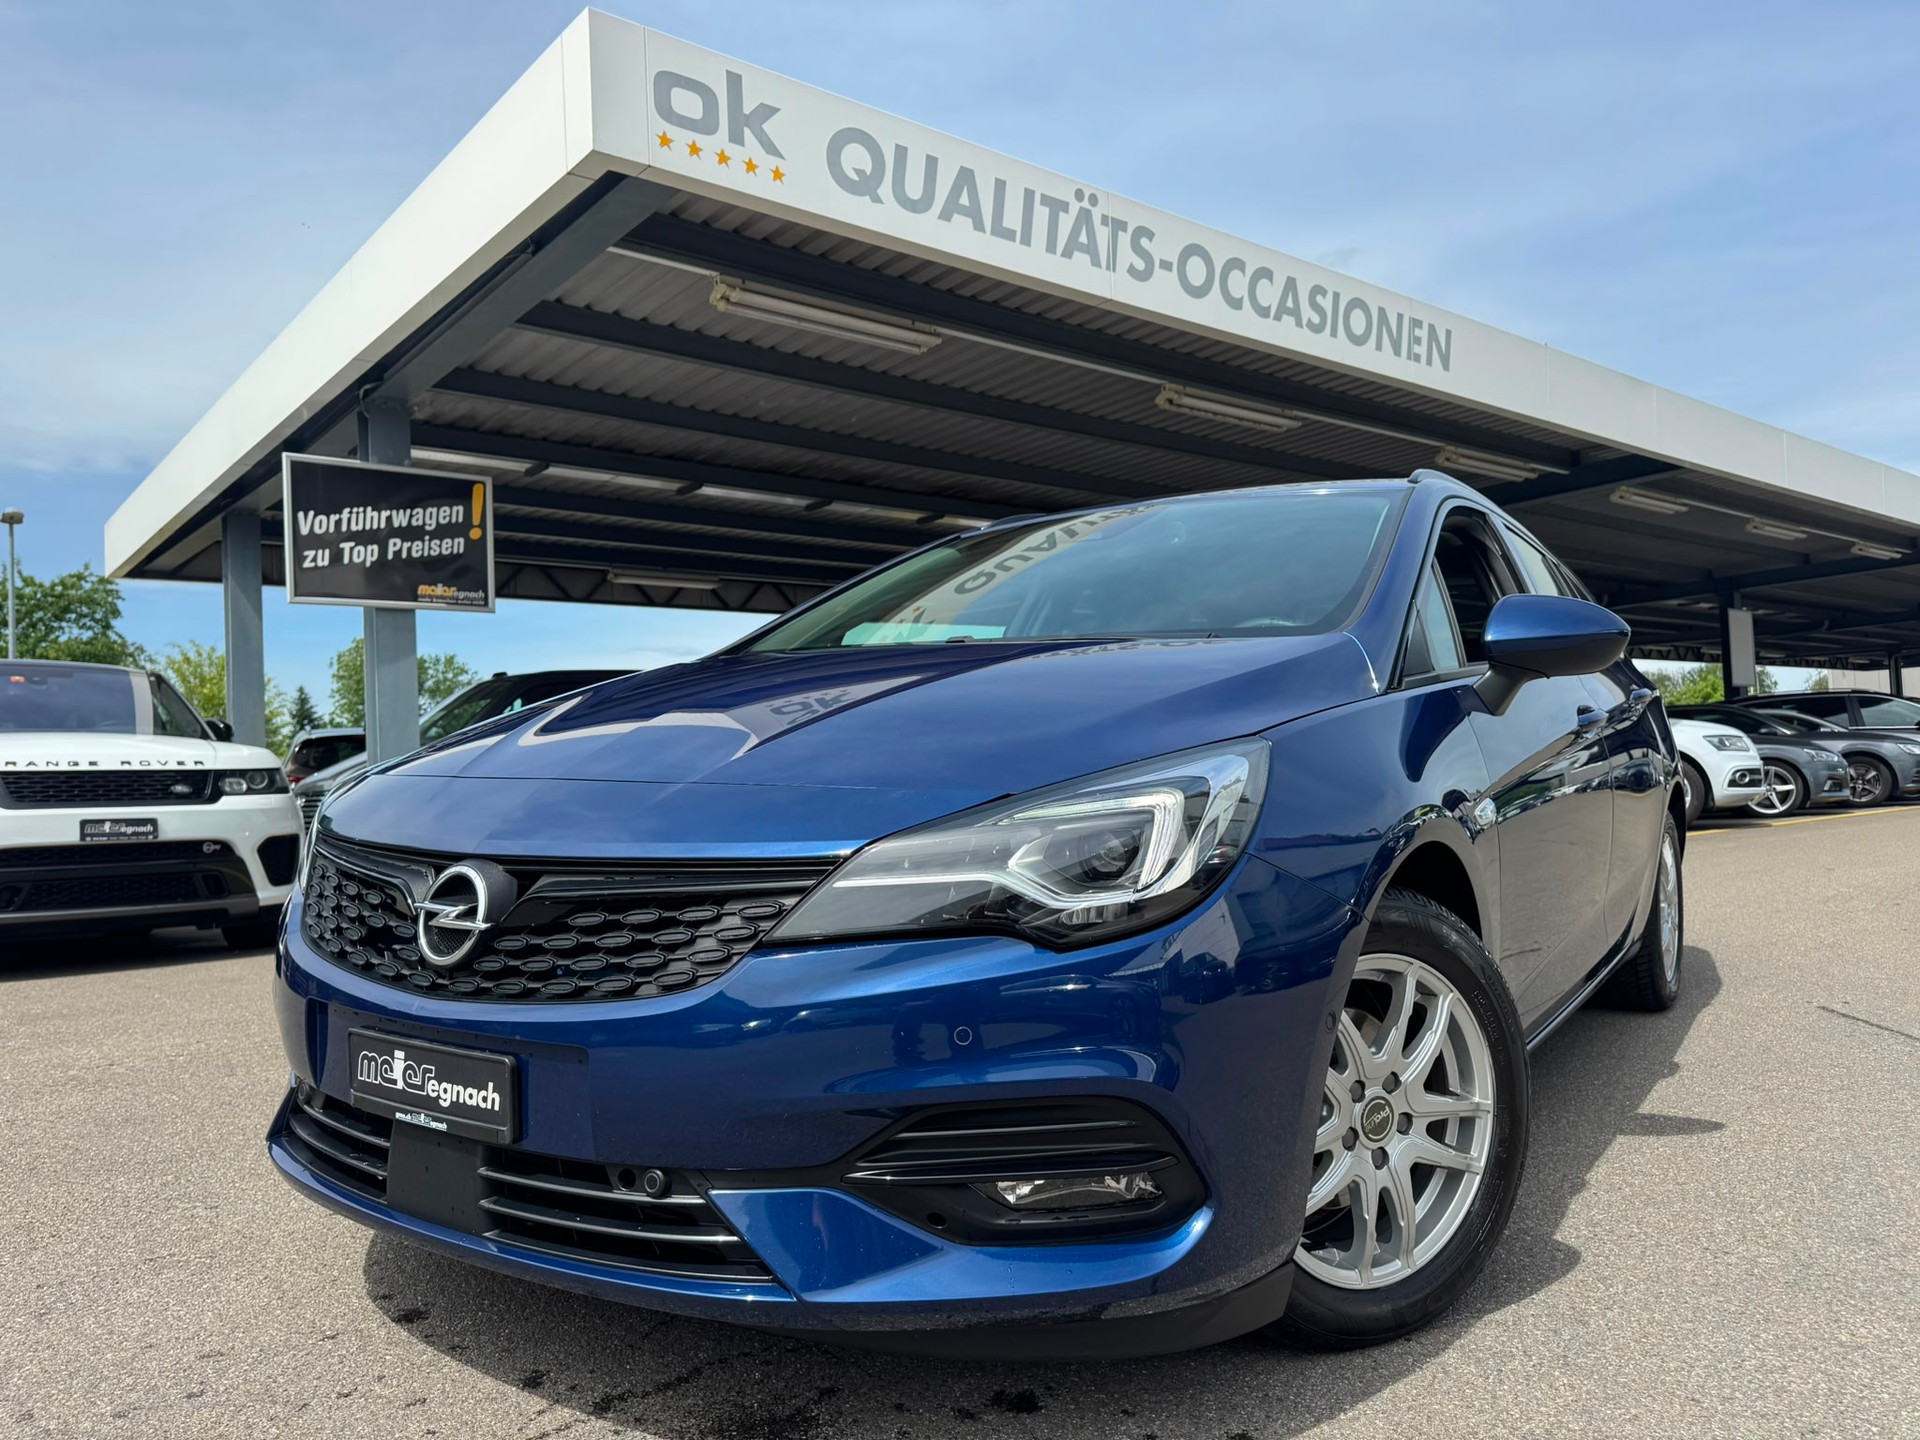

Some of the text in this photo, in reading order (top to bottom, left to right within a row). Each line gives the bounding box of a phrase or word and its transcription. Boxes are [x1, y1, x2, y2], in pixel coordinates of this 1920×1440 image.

[653, 69, 1453, 373] ok QUALITÄTS-OCCASIONEN
[297, 504, 465, 536] Vorführwagen
[302, 535, 466, 569] zu Top Preisen
[120, 759, 205, 767] ROVER
